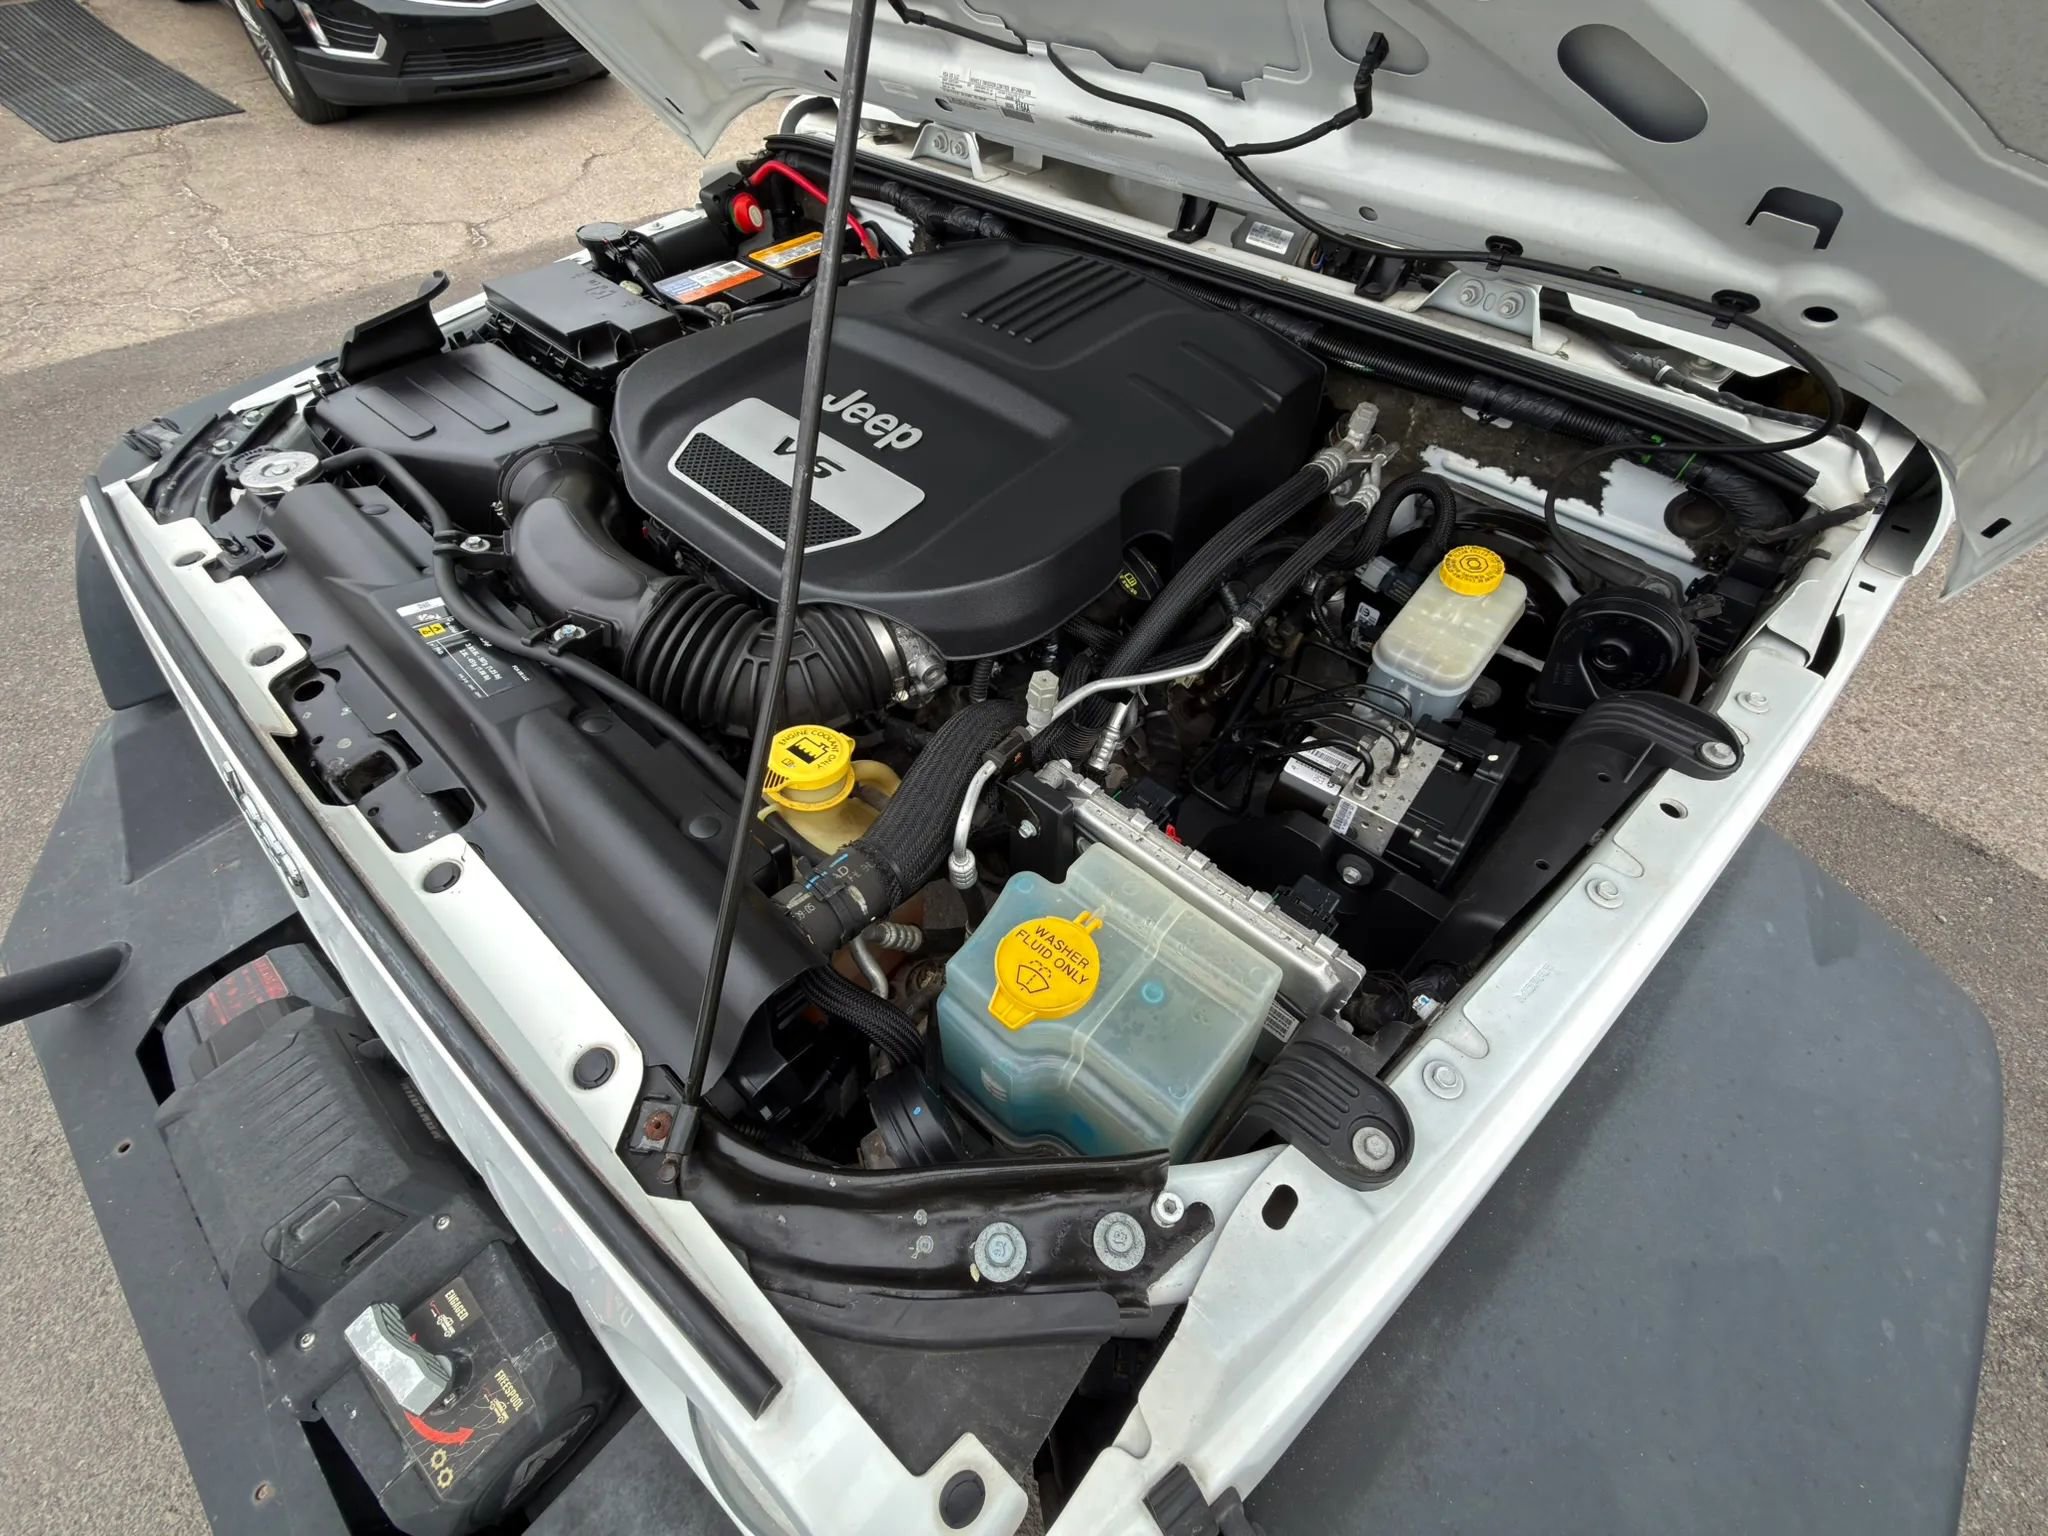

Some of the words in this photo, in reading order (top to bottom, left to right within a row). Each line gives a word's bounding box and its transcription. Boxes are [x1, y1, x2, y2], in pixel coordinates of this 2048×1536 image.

[822, 389, 923, 449] Jeep
[778, 729, 808, 746] ENGINE
[811, 729, 840, 753] COOLANT
[816, 754, 837, 769] ONLY
[1015, 929, 1053, 959] FLUID
[1053, 957, 1090, 985] ONLY
[1035, 925, 1090, 969] WASHER
[444, 1289, 469, 1321] ENGAGED
[493, 1369, 524, 1412] FREESPOOL
